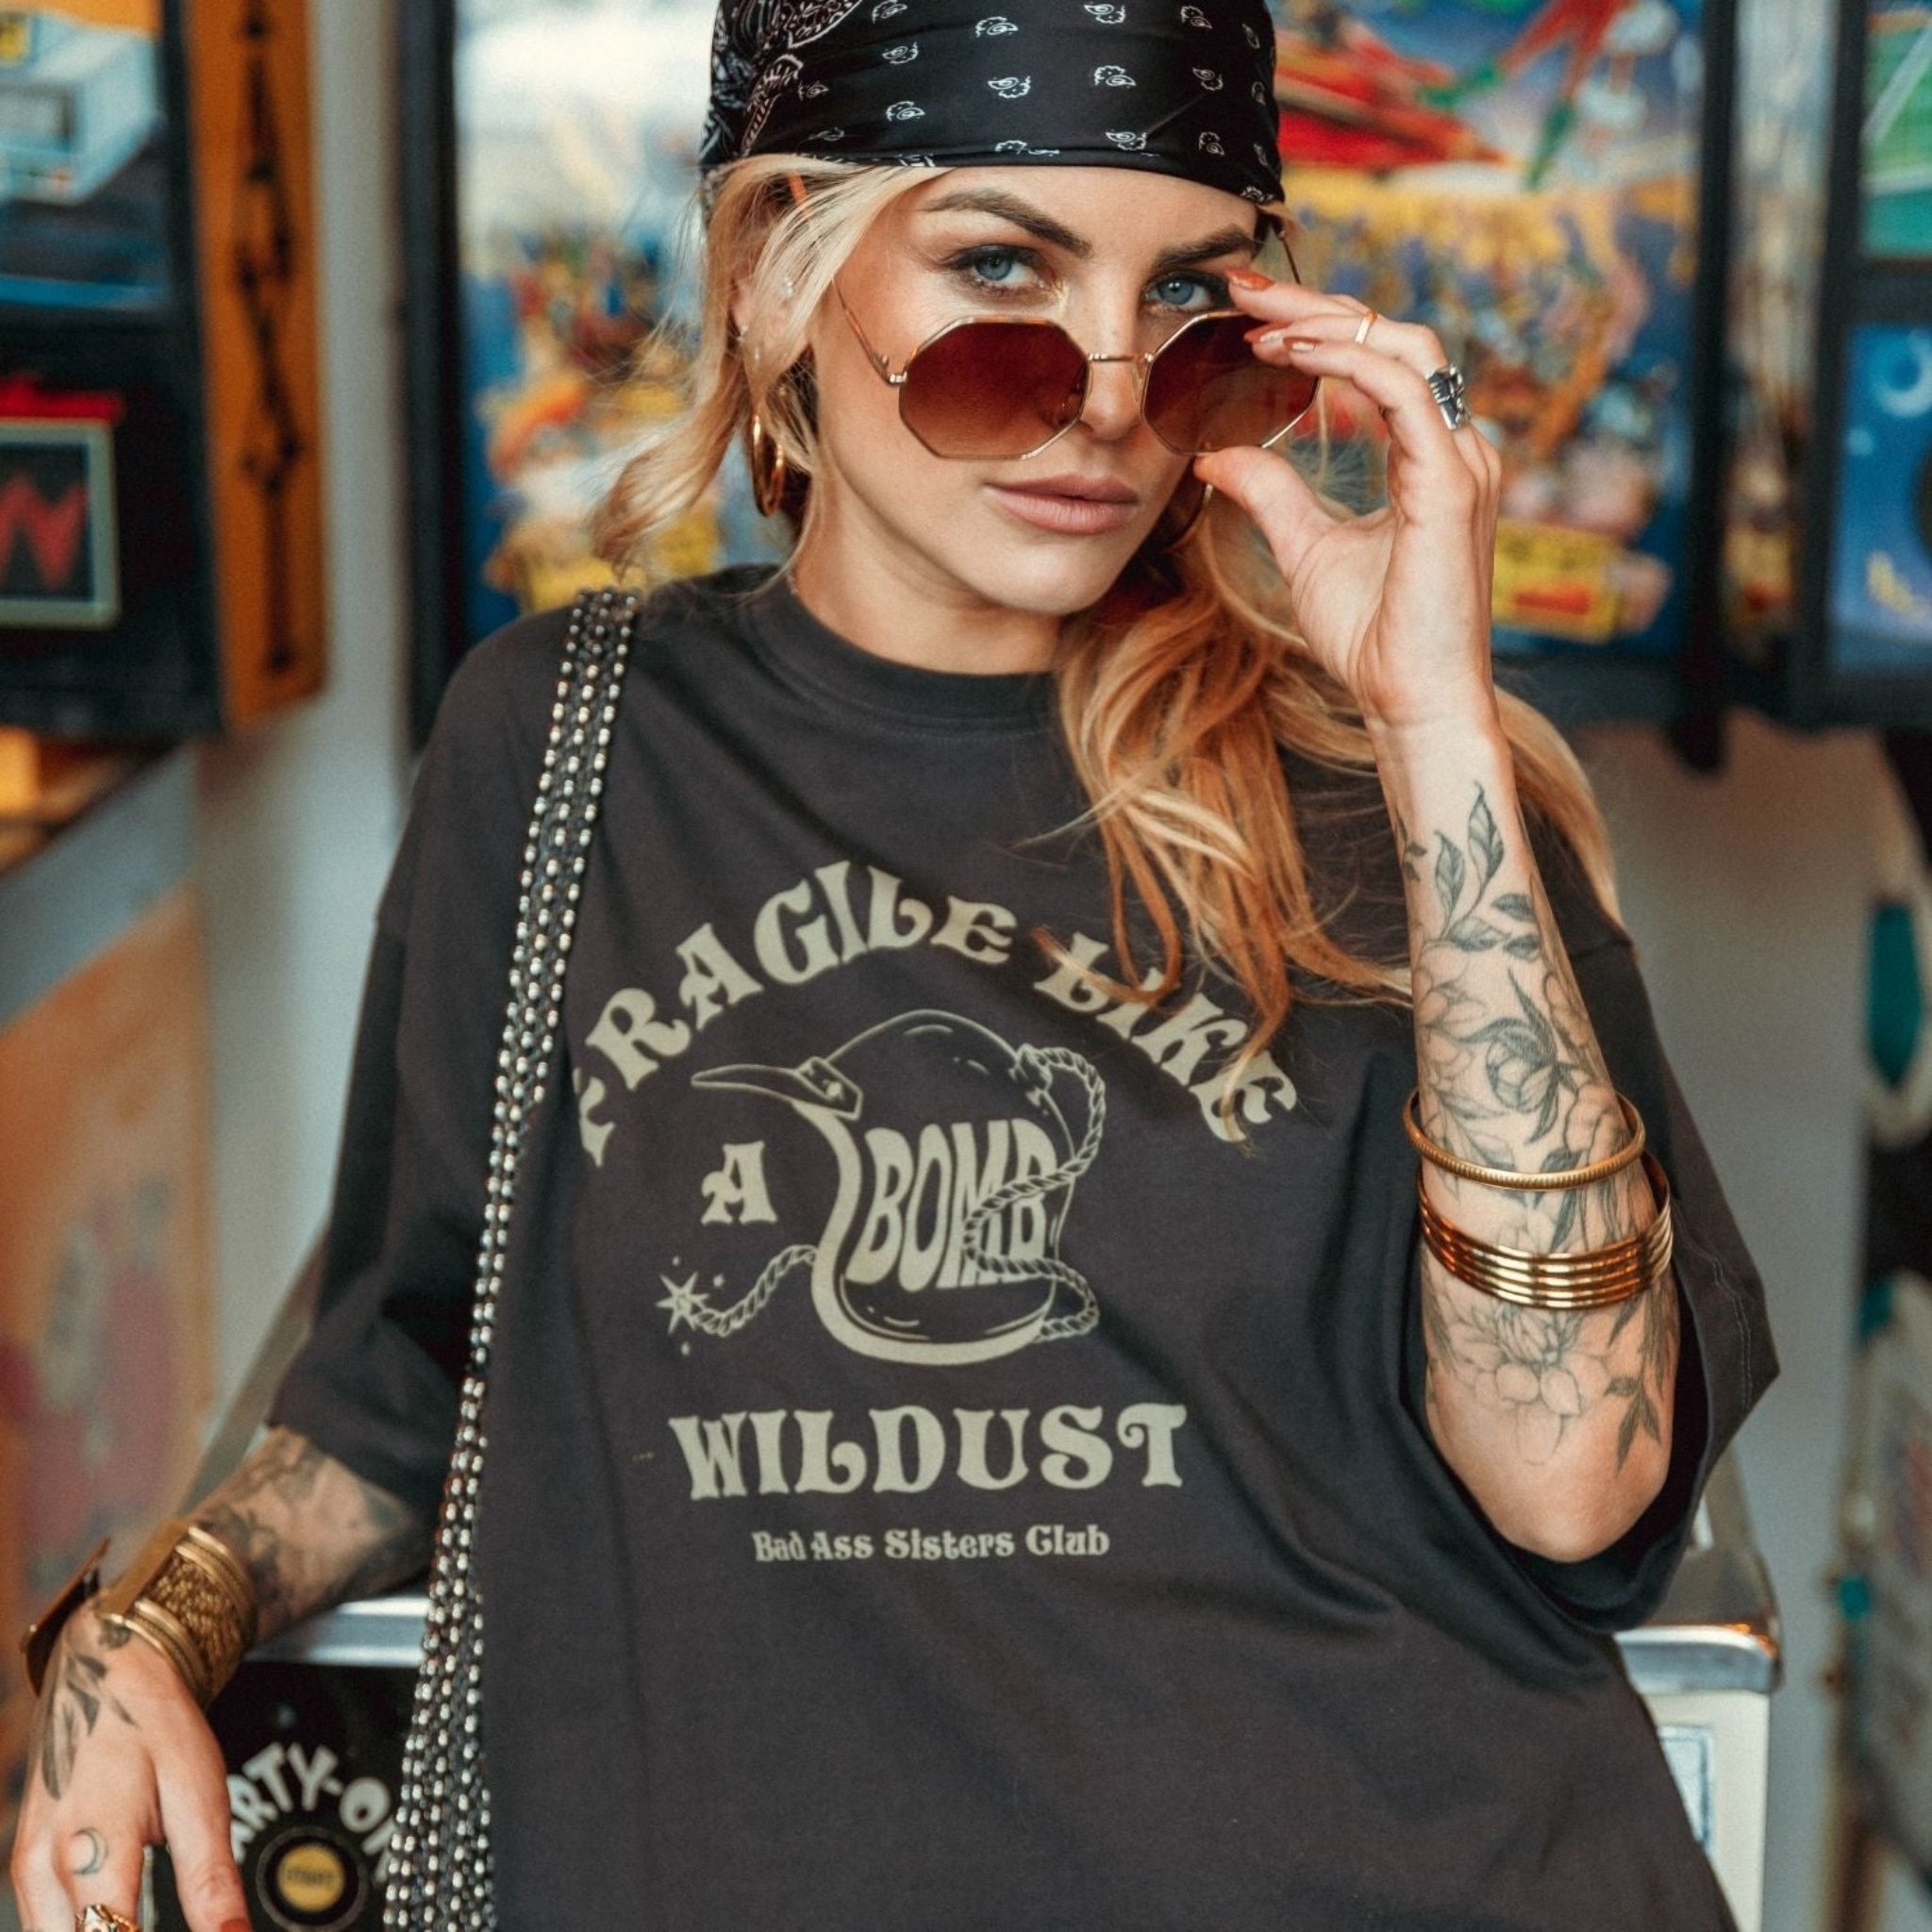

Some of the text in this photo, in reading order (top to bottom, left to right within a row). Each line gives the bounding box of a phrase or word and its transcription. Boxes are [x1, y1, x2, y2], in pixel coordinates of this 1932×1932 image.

[700, 1140, 778, 1225] A
[845, 1117, 1058, 1292] BOMB
[667, 1402, 1188, 1501] WILDUST
[752, 1523, 1111, 1562] Bad Ass Sisters Club
